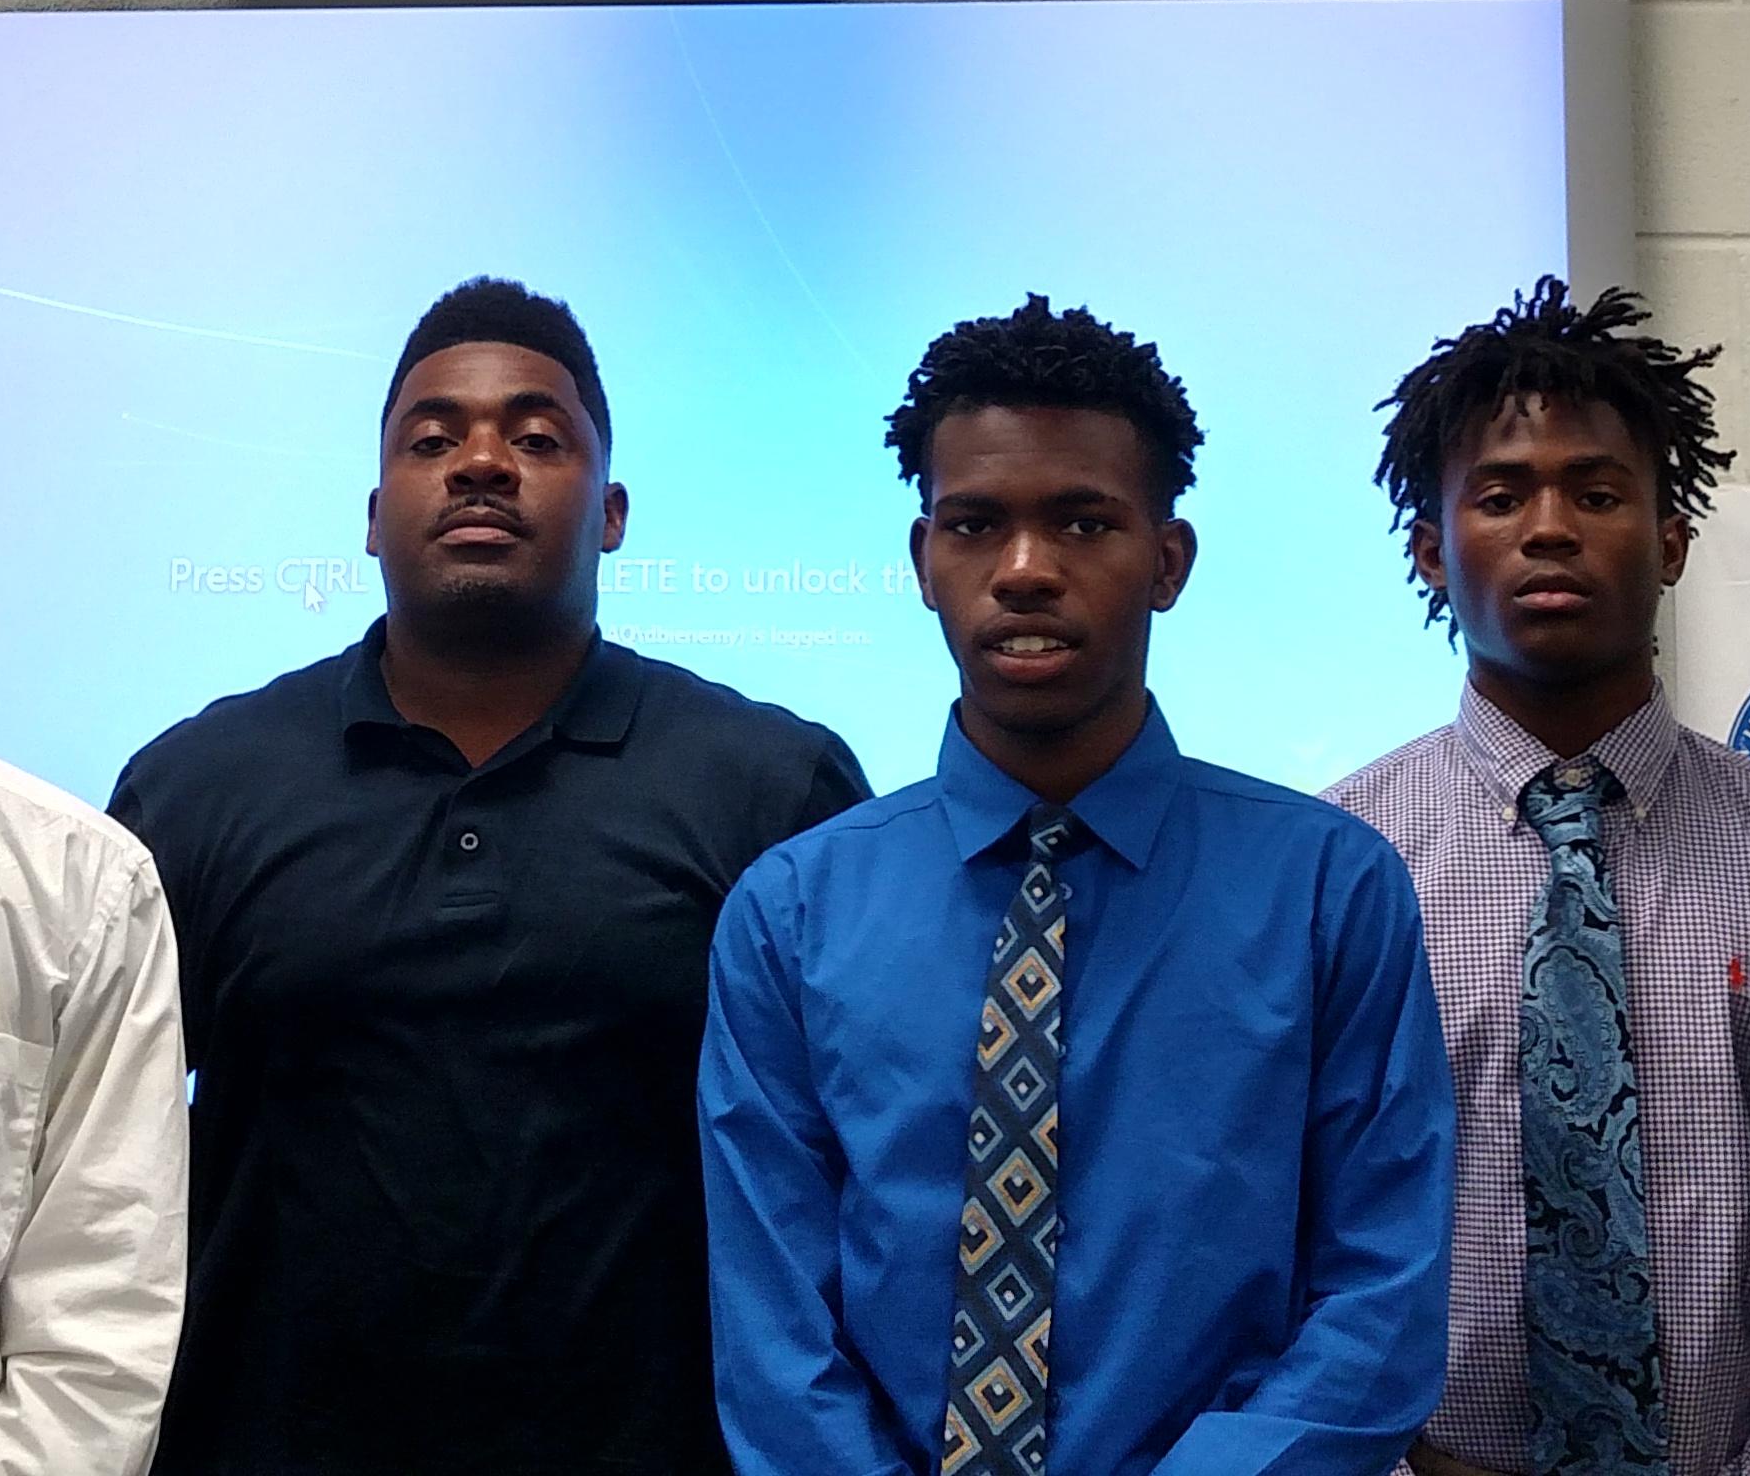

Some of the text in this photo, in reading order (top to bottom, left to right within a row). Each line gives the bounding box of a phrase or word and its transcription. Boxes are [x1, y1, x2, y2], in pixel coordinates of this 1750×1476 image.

[170, 557, 368, 593] Press CTRL
[599, 559, 677, 593] LETE
[692, 562, 729, 592] to
[743, 559, 868, 594] unlock
